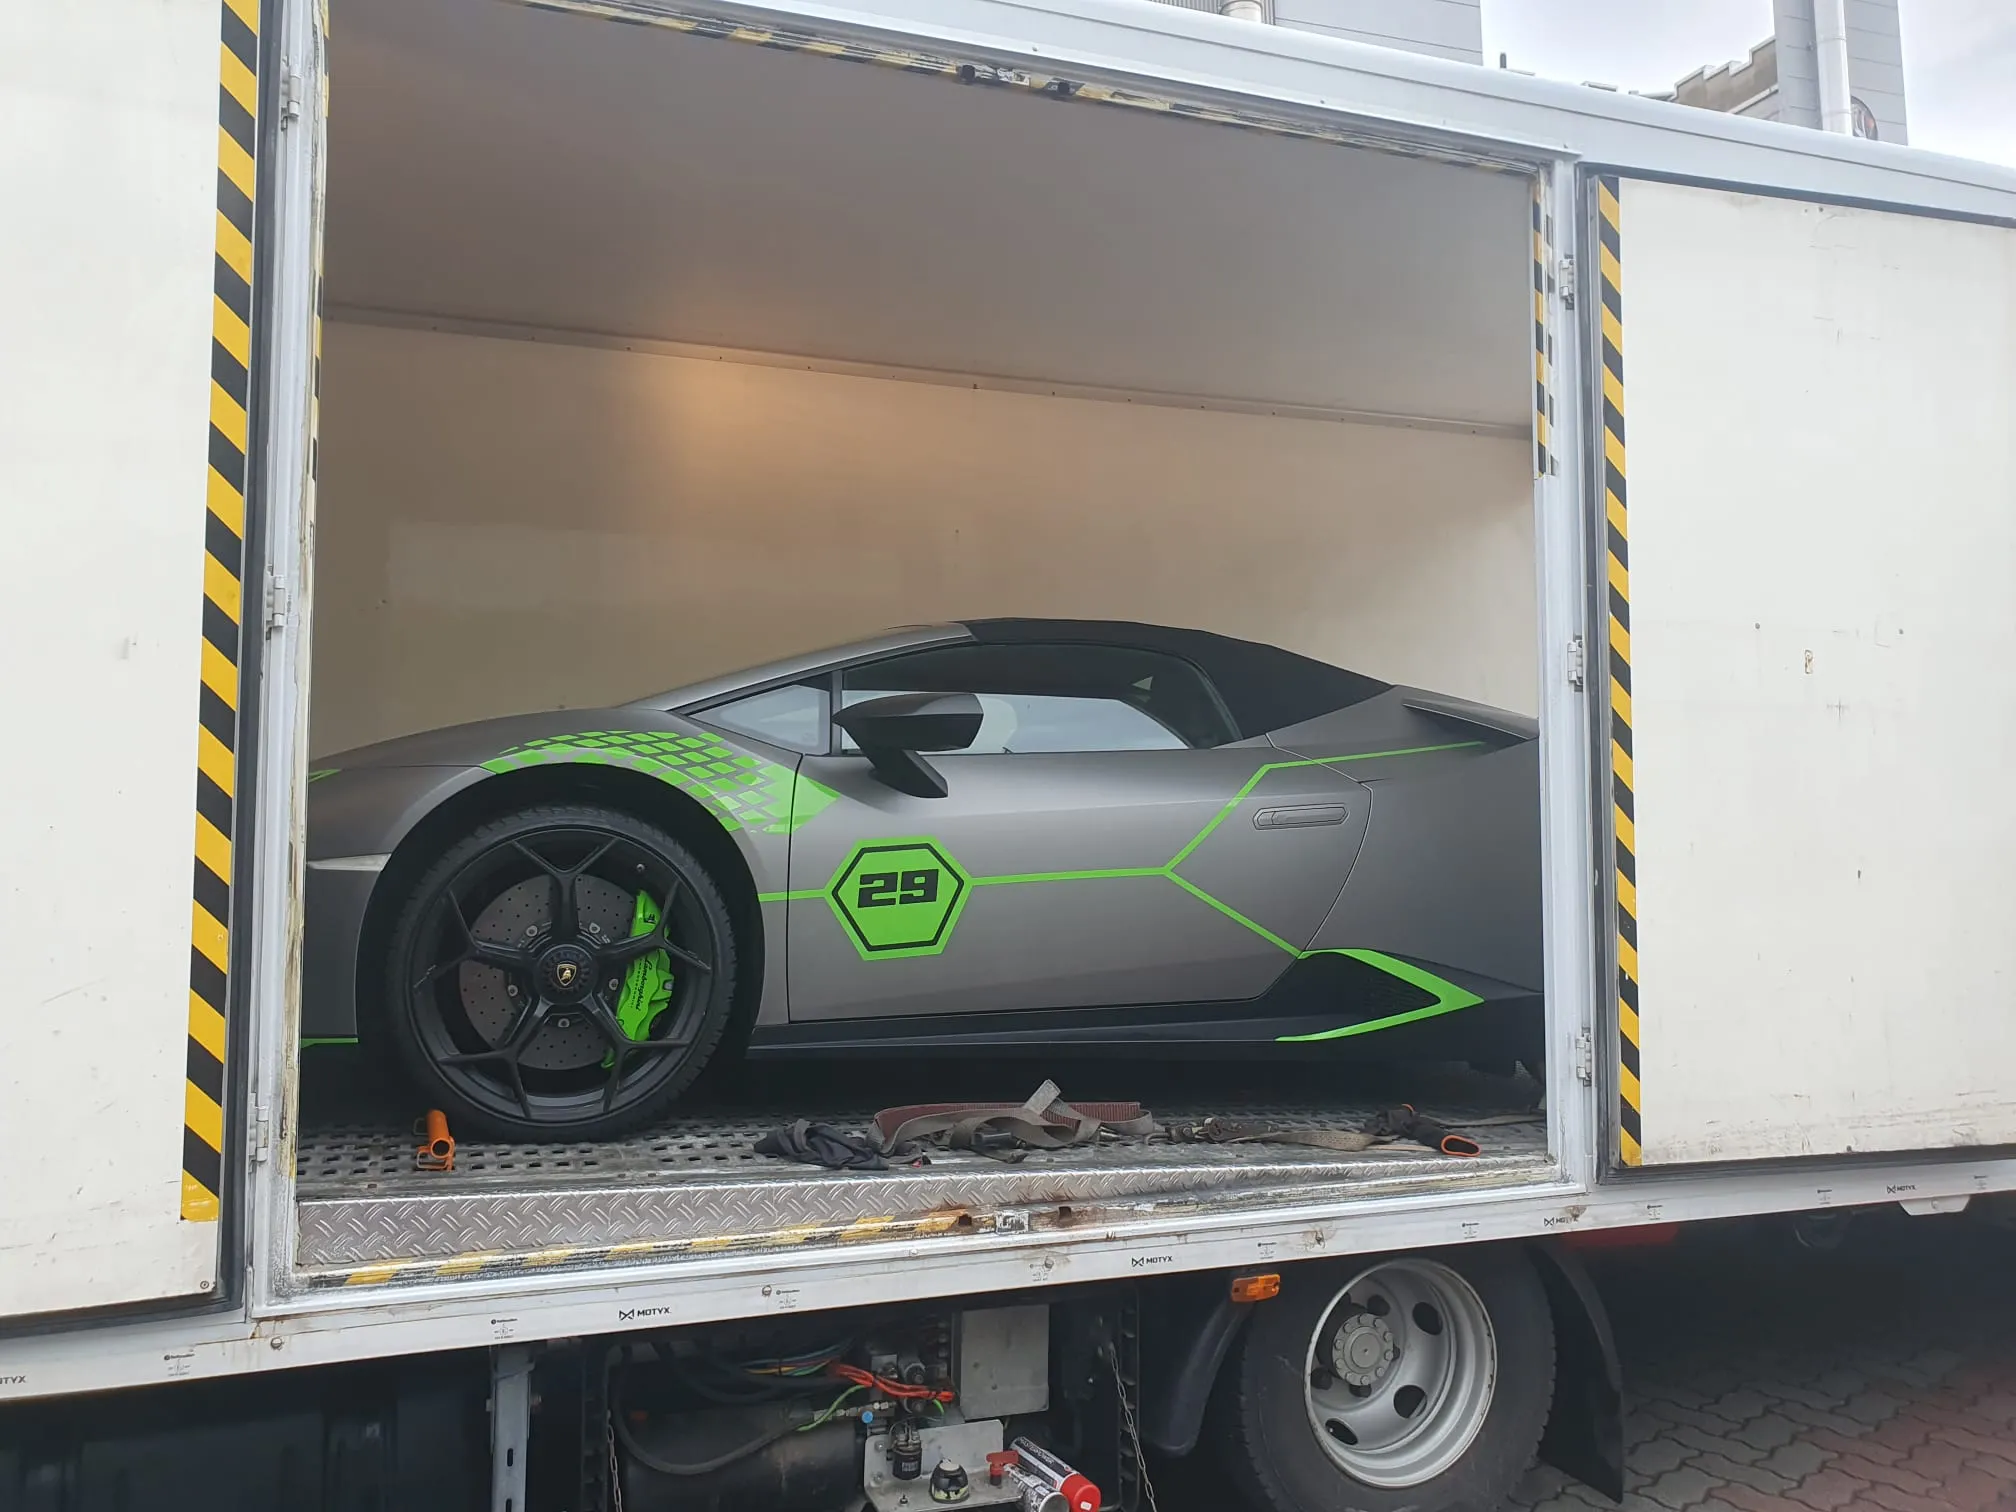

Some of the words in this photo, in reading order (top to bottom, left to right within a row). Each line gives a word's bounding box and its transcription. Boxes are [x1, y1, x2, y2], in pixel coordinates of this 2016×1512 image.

[858, 869, 938, 908] 29
[1146, 1256, 1172, 1264] MOTYX
[637, 1306, 670, 1317] MOTYX
